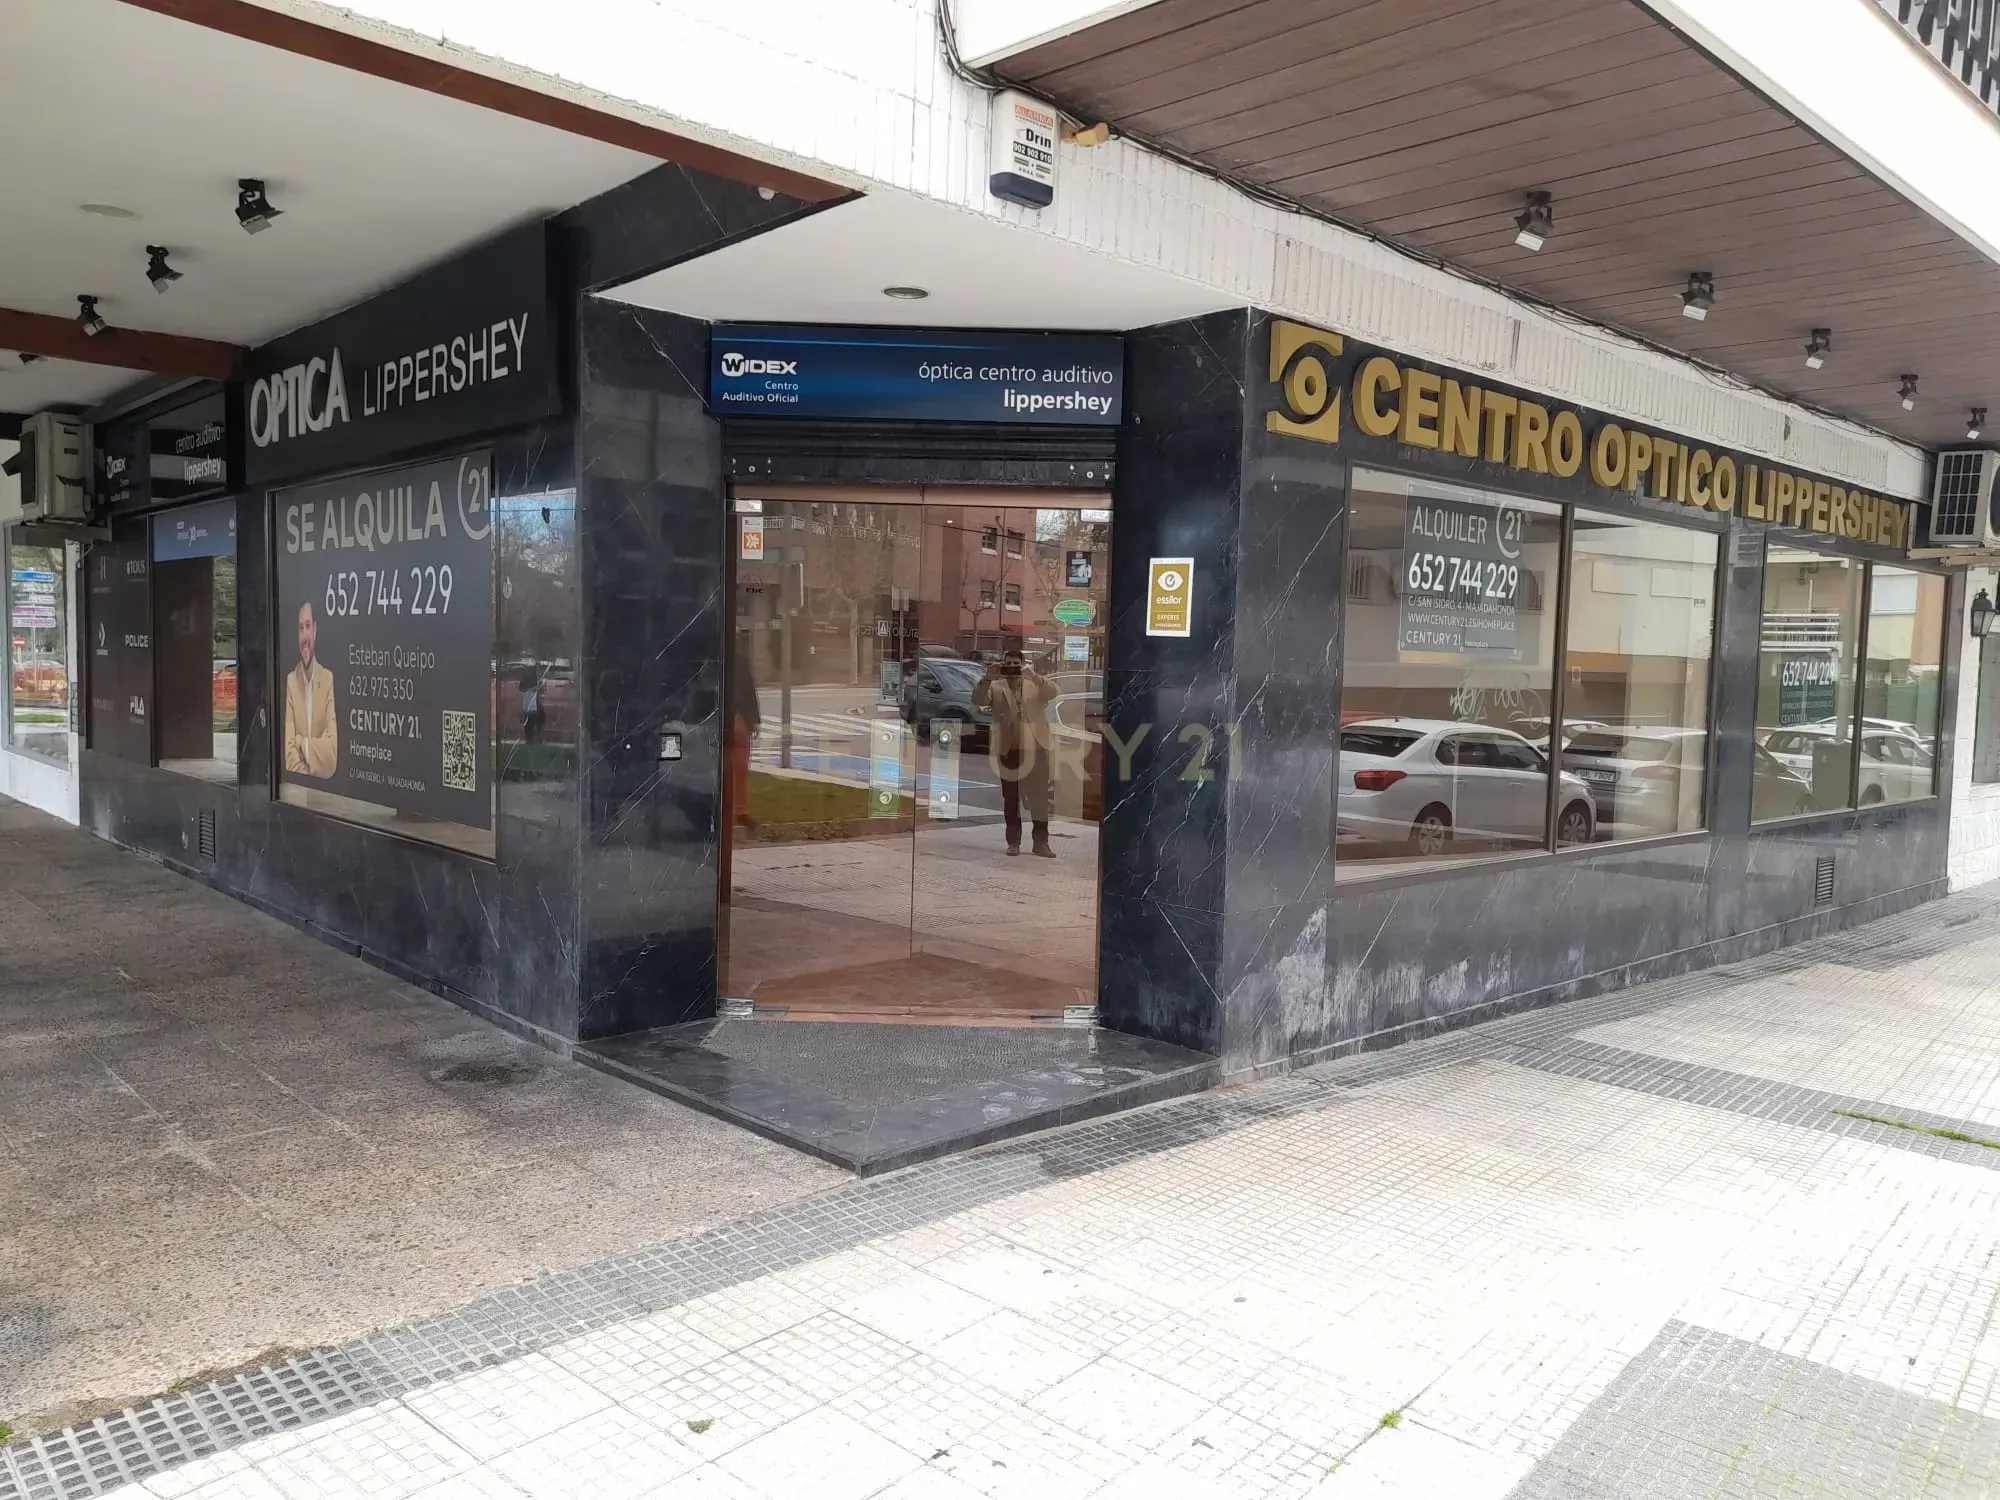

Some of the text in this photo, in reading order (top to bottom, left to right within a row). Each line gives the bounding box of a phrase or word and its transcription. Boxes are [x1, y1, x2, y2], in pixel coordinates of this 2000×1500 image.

[1014, 142, 1026, 154] 902
[1026, 128, 1051, 148] Drin
[722, 352, 798, 376] WIDEX
[919, 362, 1112, 384] óptica centro auditivo
[250, 312, 528, 447] OPTICA LIPPERSHEY
[765, 380, 798, 390] Centro
[722, 392, 798, 402] Auditivo Oficial
[1004, 389, 1112, 414] lippershey
[176, 424, 220, 454] centro auditivo
[1352, 356, 1909, 548] CENTRO OPTICO LIPPERSHEY
[184, 454, 221, 485] lippershey
[286, 480, 447, 554] SE ALQUILA
[1412, 505, 1487, 544] ALQUILER
[1409, 552, 1518, 599] 652 744 229
[326, 564, 452, 616] 652 744 229
[1156, 595, 1182, 604] essilor
[1417, 596, 1432, 608] SAN
[125, 634, 148, 648] POLICE
[1406, 630, 1451, 646] CENTURY
[349, 644, 435, 676] Esteban Queipo
[1782, 662, 1835, 686] 652 744 229
[350, 676, 414, 700] 632 975 350
[350, 708, 404, 737] CENTURY
[350, 740, 392, 762] Homeplace
